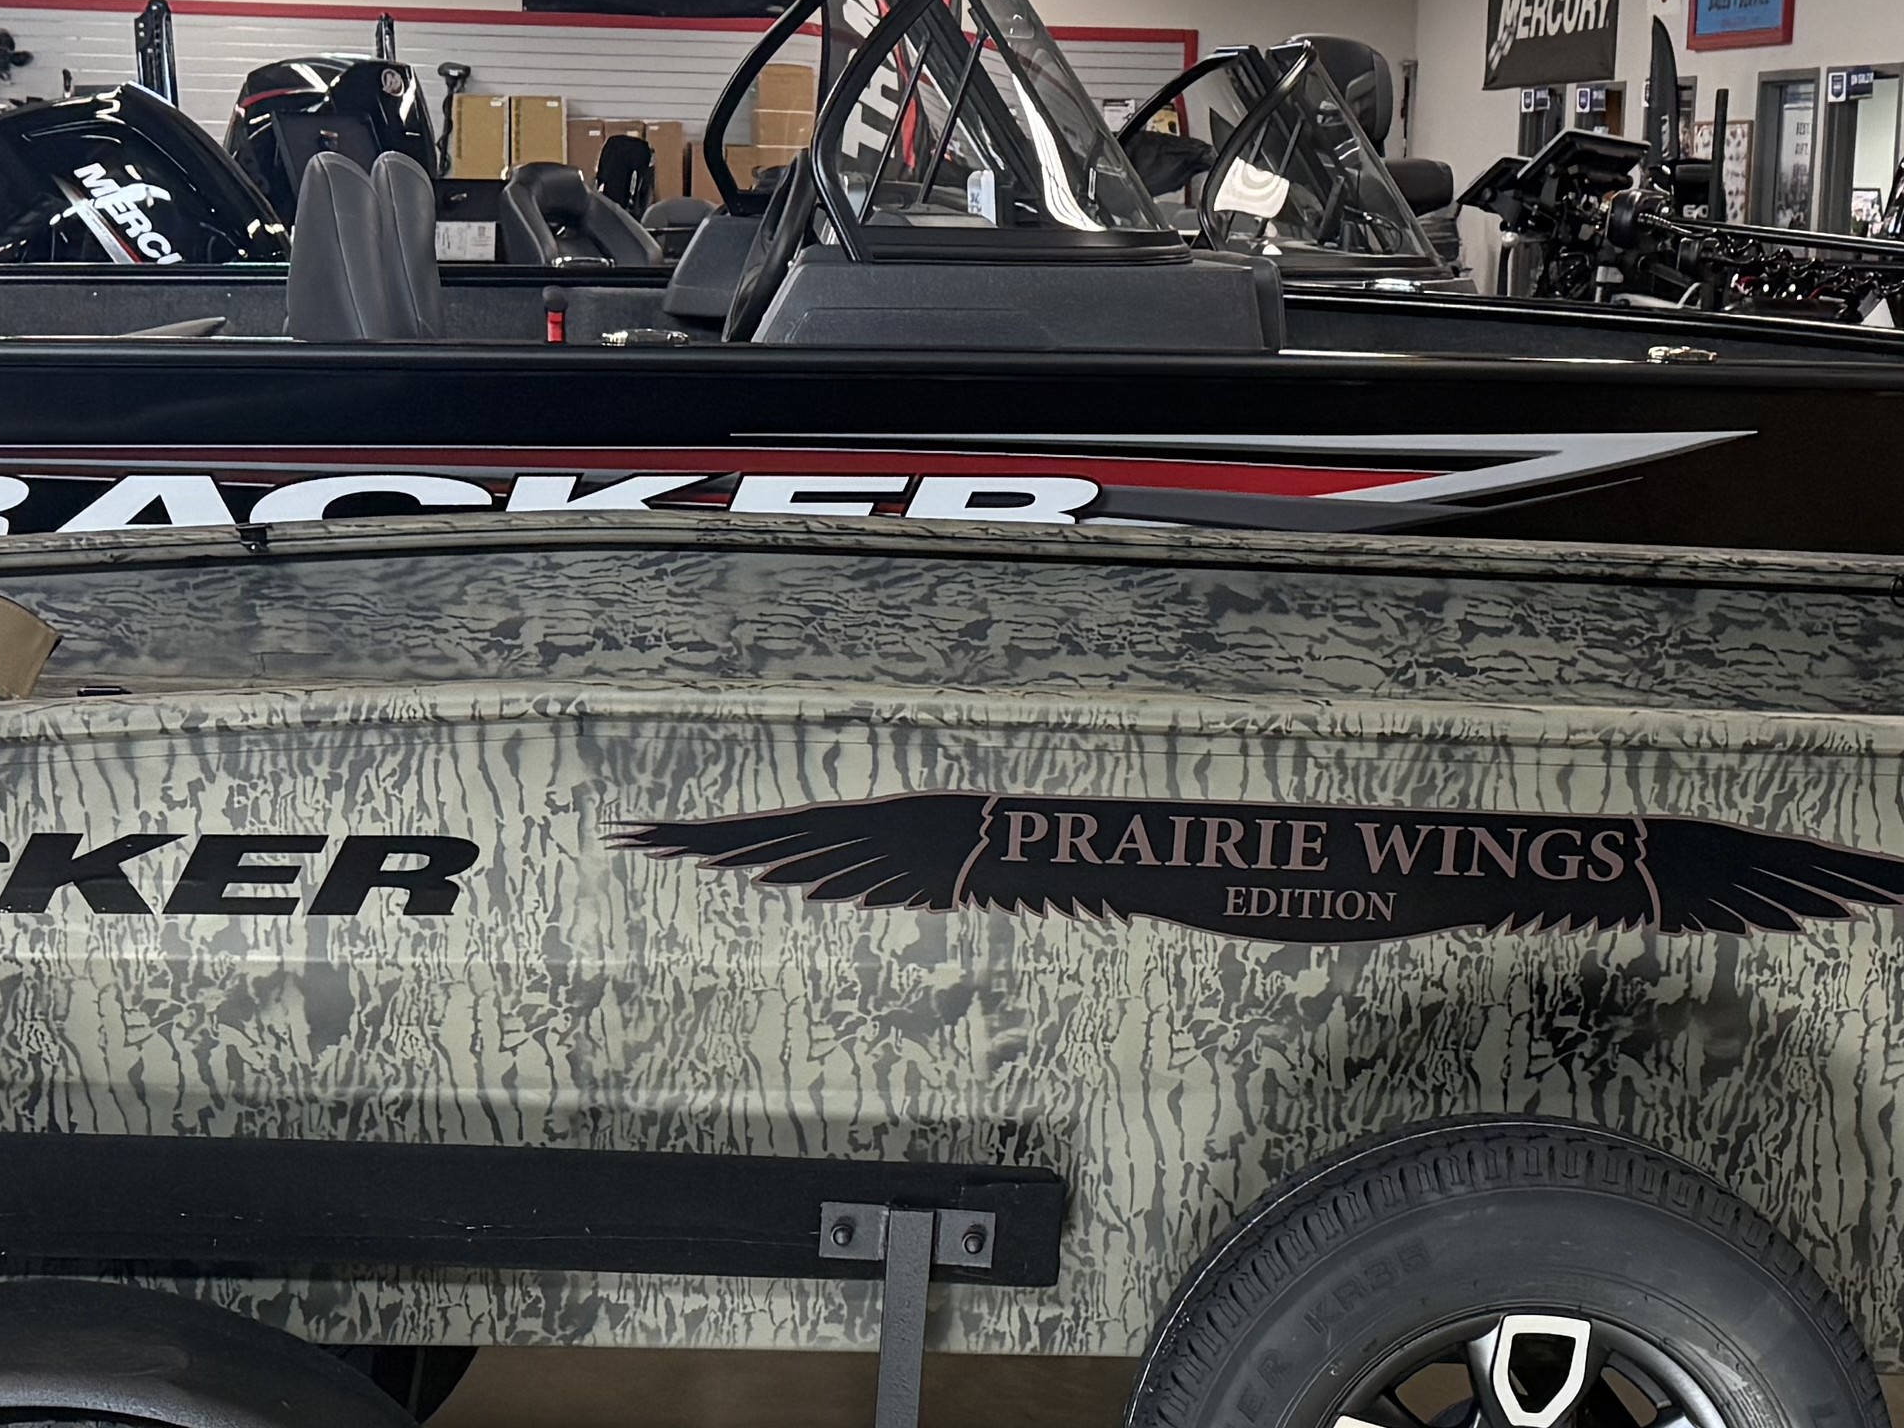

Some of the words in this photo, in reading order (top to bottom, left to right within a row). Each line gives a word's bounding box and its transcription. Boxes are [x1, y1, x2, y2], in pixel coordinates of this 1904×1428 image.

[1002, 808, 1330, 872] PRAIRIE
[1354, 821, 1626, 884] WINGS
[1223, 885, 1395, 923] EDITION
